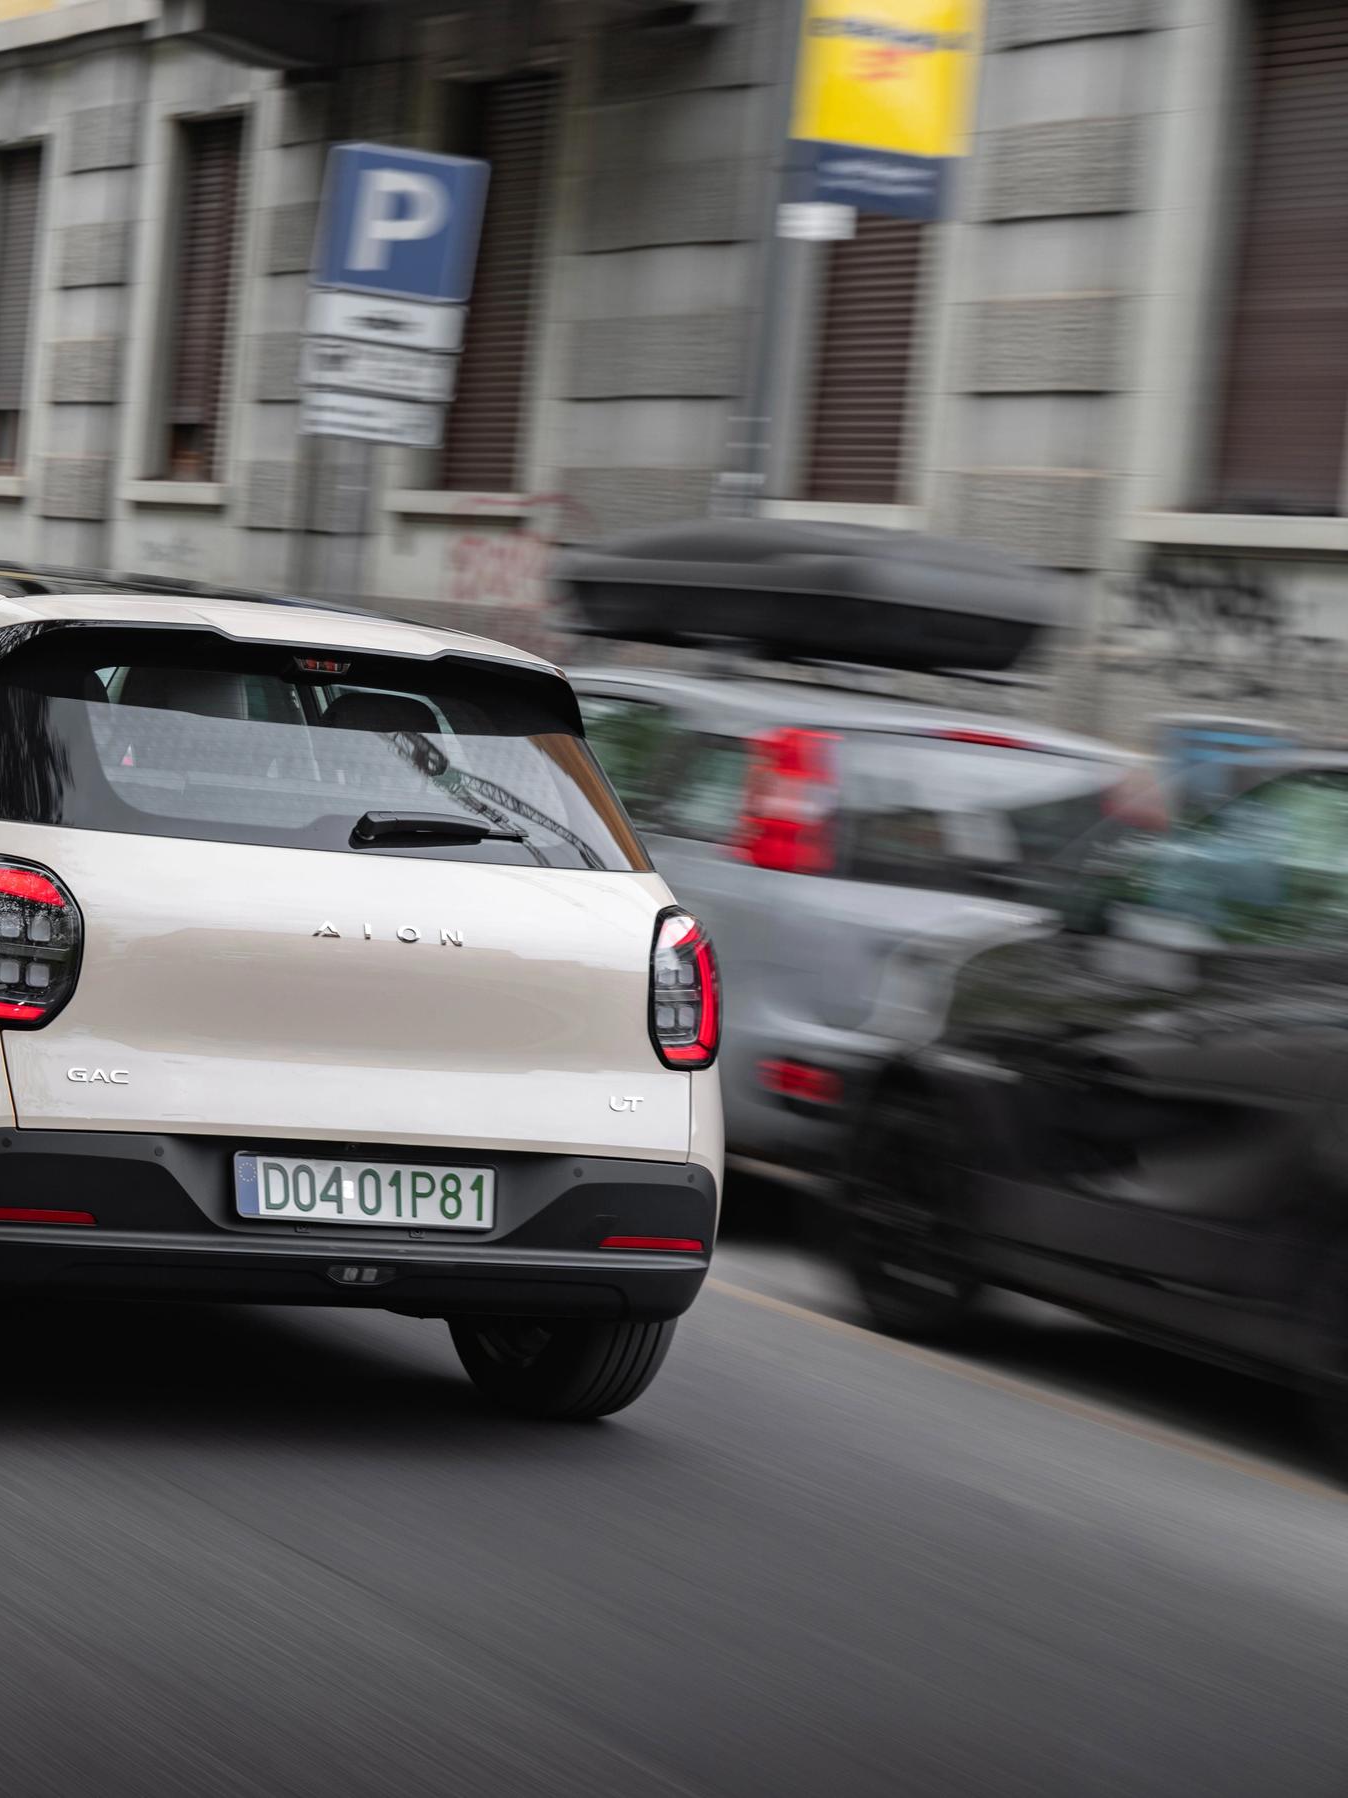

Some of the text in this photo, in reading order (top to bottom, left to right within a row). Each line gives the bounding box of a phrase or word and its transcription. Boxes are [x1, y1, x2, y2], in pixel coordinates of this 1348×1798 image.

[344, 168, 452, 271] P
[312, 920, 463, 947] AION
[67, 1067, 130, 1085] GAC
[609, 1095, 644, 1112] UT
